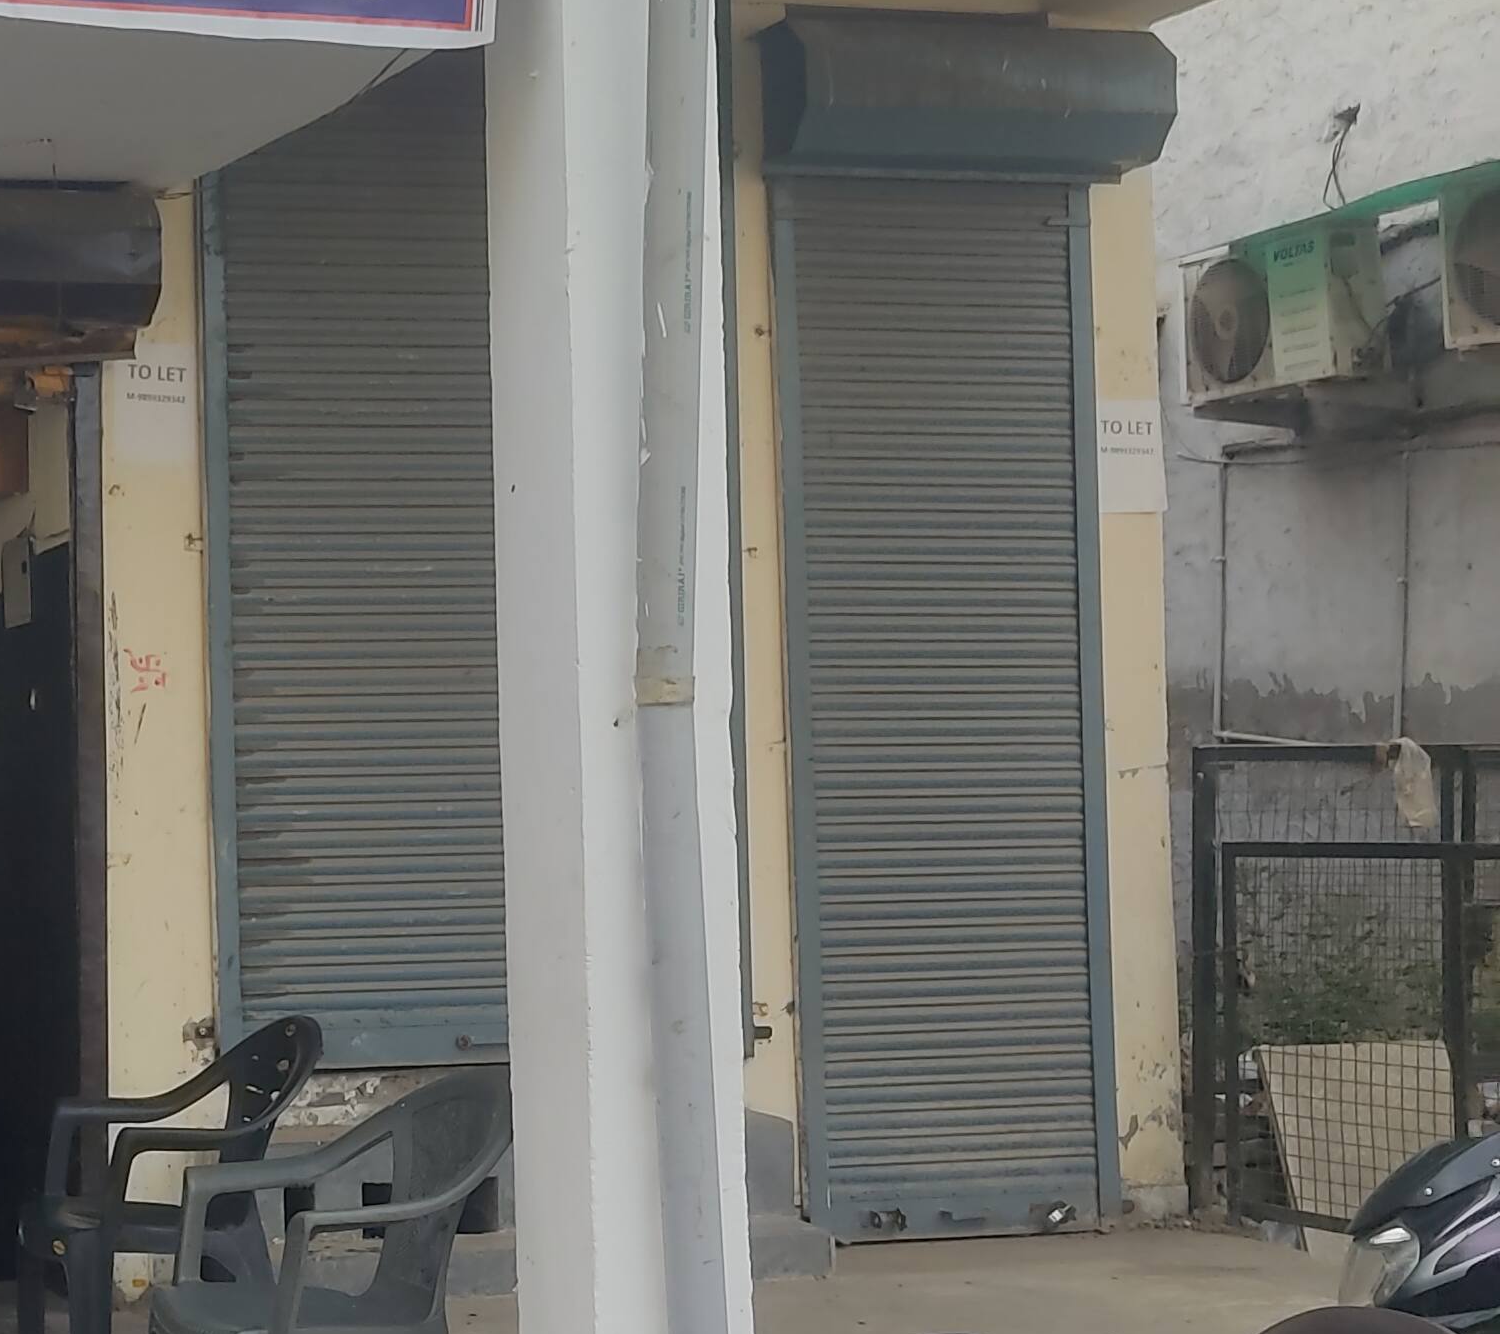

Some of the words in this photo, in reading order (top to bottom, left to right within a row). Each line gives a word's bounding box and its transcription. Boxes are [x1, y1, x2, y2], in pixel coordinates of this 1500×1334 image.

[1272, 239, 1316, 263] VOLTAS
[127, 363, 152, 380] TO
[157, 365, 188, 383] LET
[1100, 419, 1123, 435] TO
[1126, 419, 1154, 436] LET
